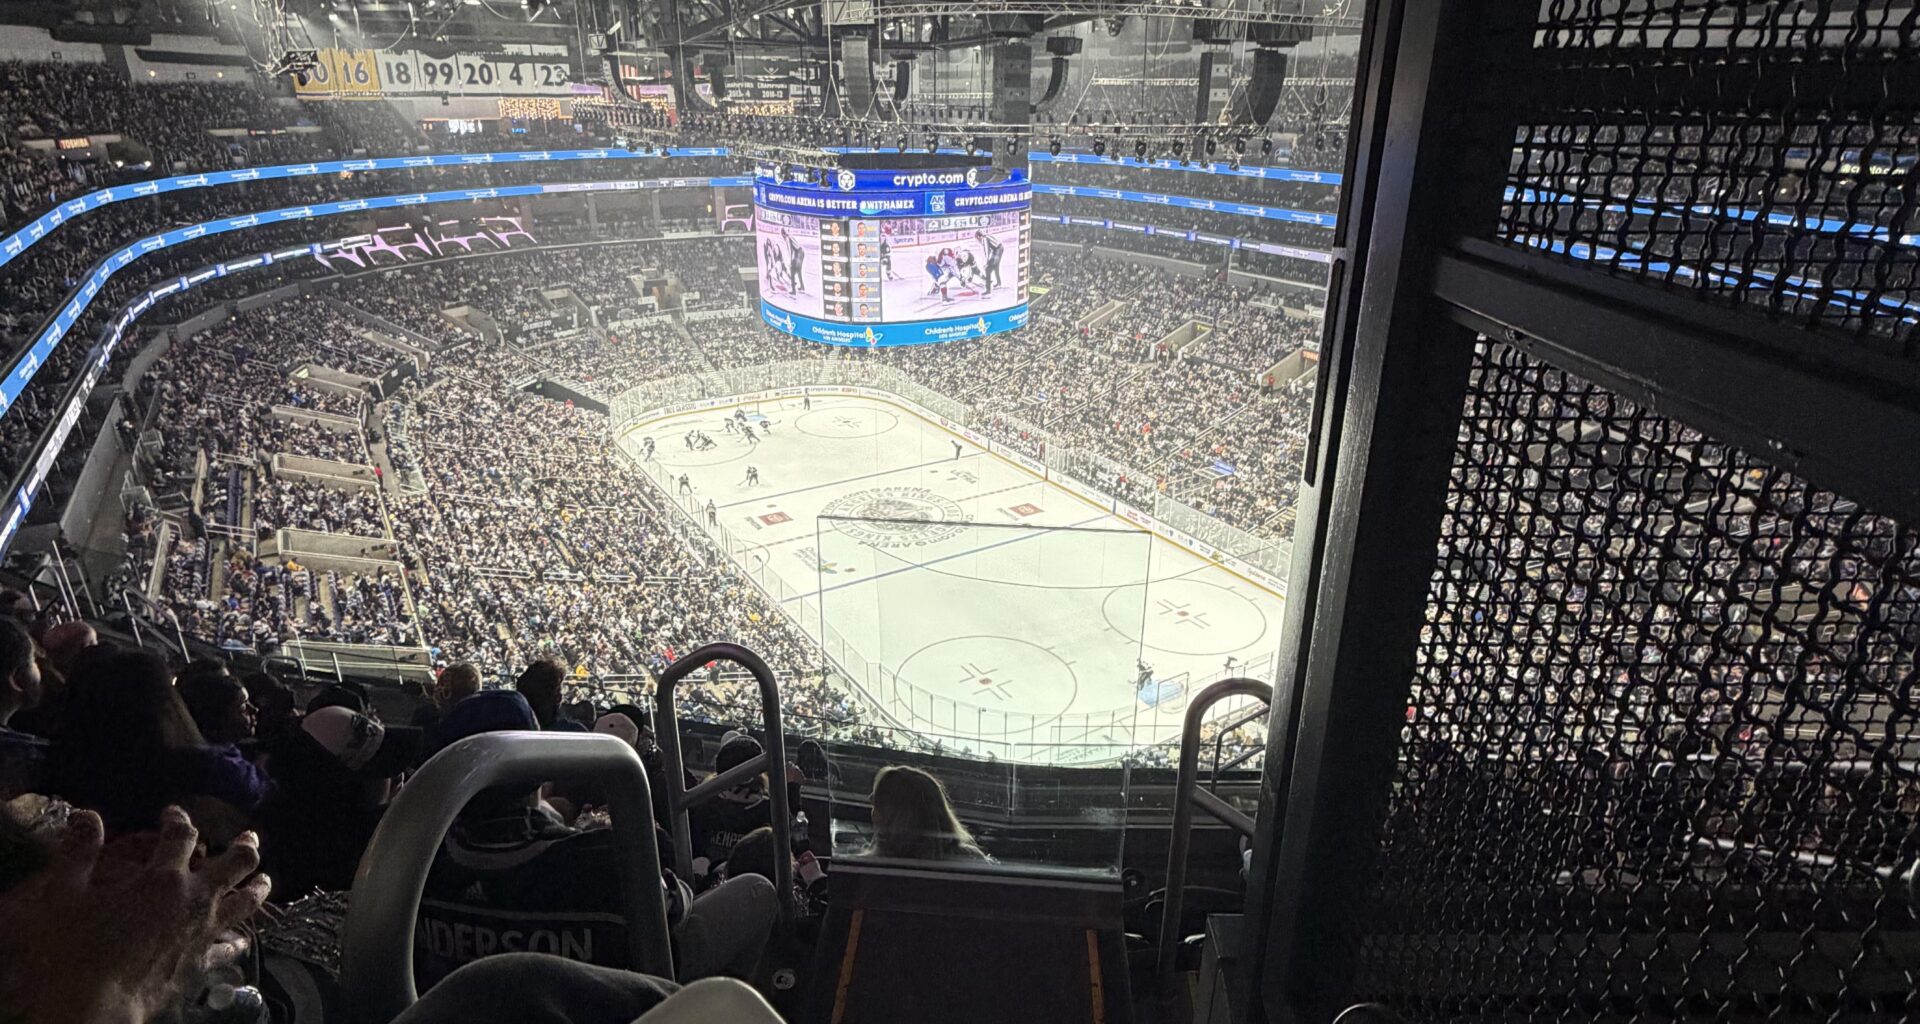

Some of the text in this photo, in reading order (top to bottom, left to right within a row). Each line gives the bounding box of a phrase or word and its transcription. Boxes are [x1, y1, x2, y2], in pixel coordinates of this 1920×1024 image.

[343, 61, 369, 84] 16
[385, 61, 411, 84] 18
[423, 62, 453, 84] 99
[464, 63, 493, 85] 20
[509, 63, 523, 86] 4
[541, 65, 566, 87] 23
[893, 173, 964, 187] crypto.com
[826, 200, 857, 210] BETTER
[955, 195, 998, 207] CRYPTO.COM
[837, 331, 866, 341] Hospital
[413, 917, 593, 961] NDERSON
